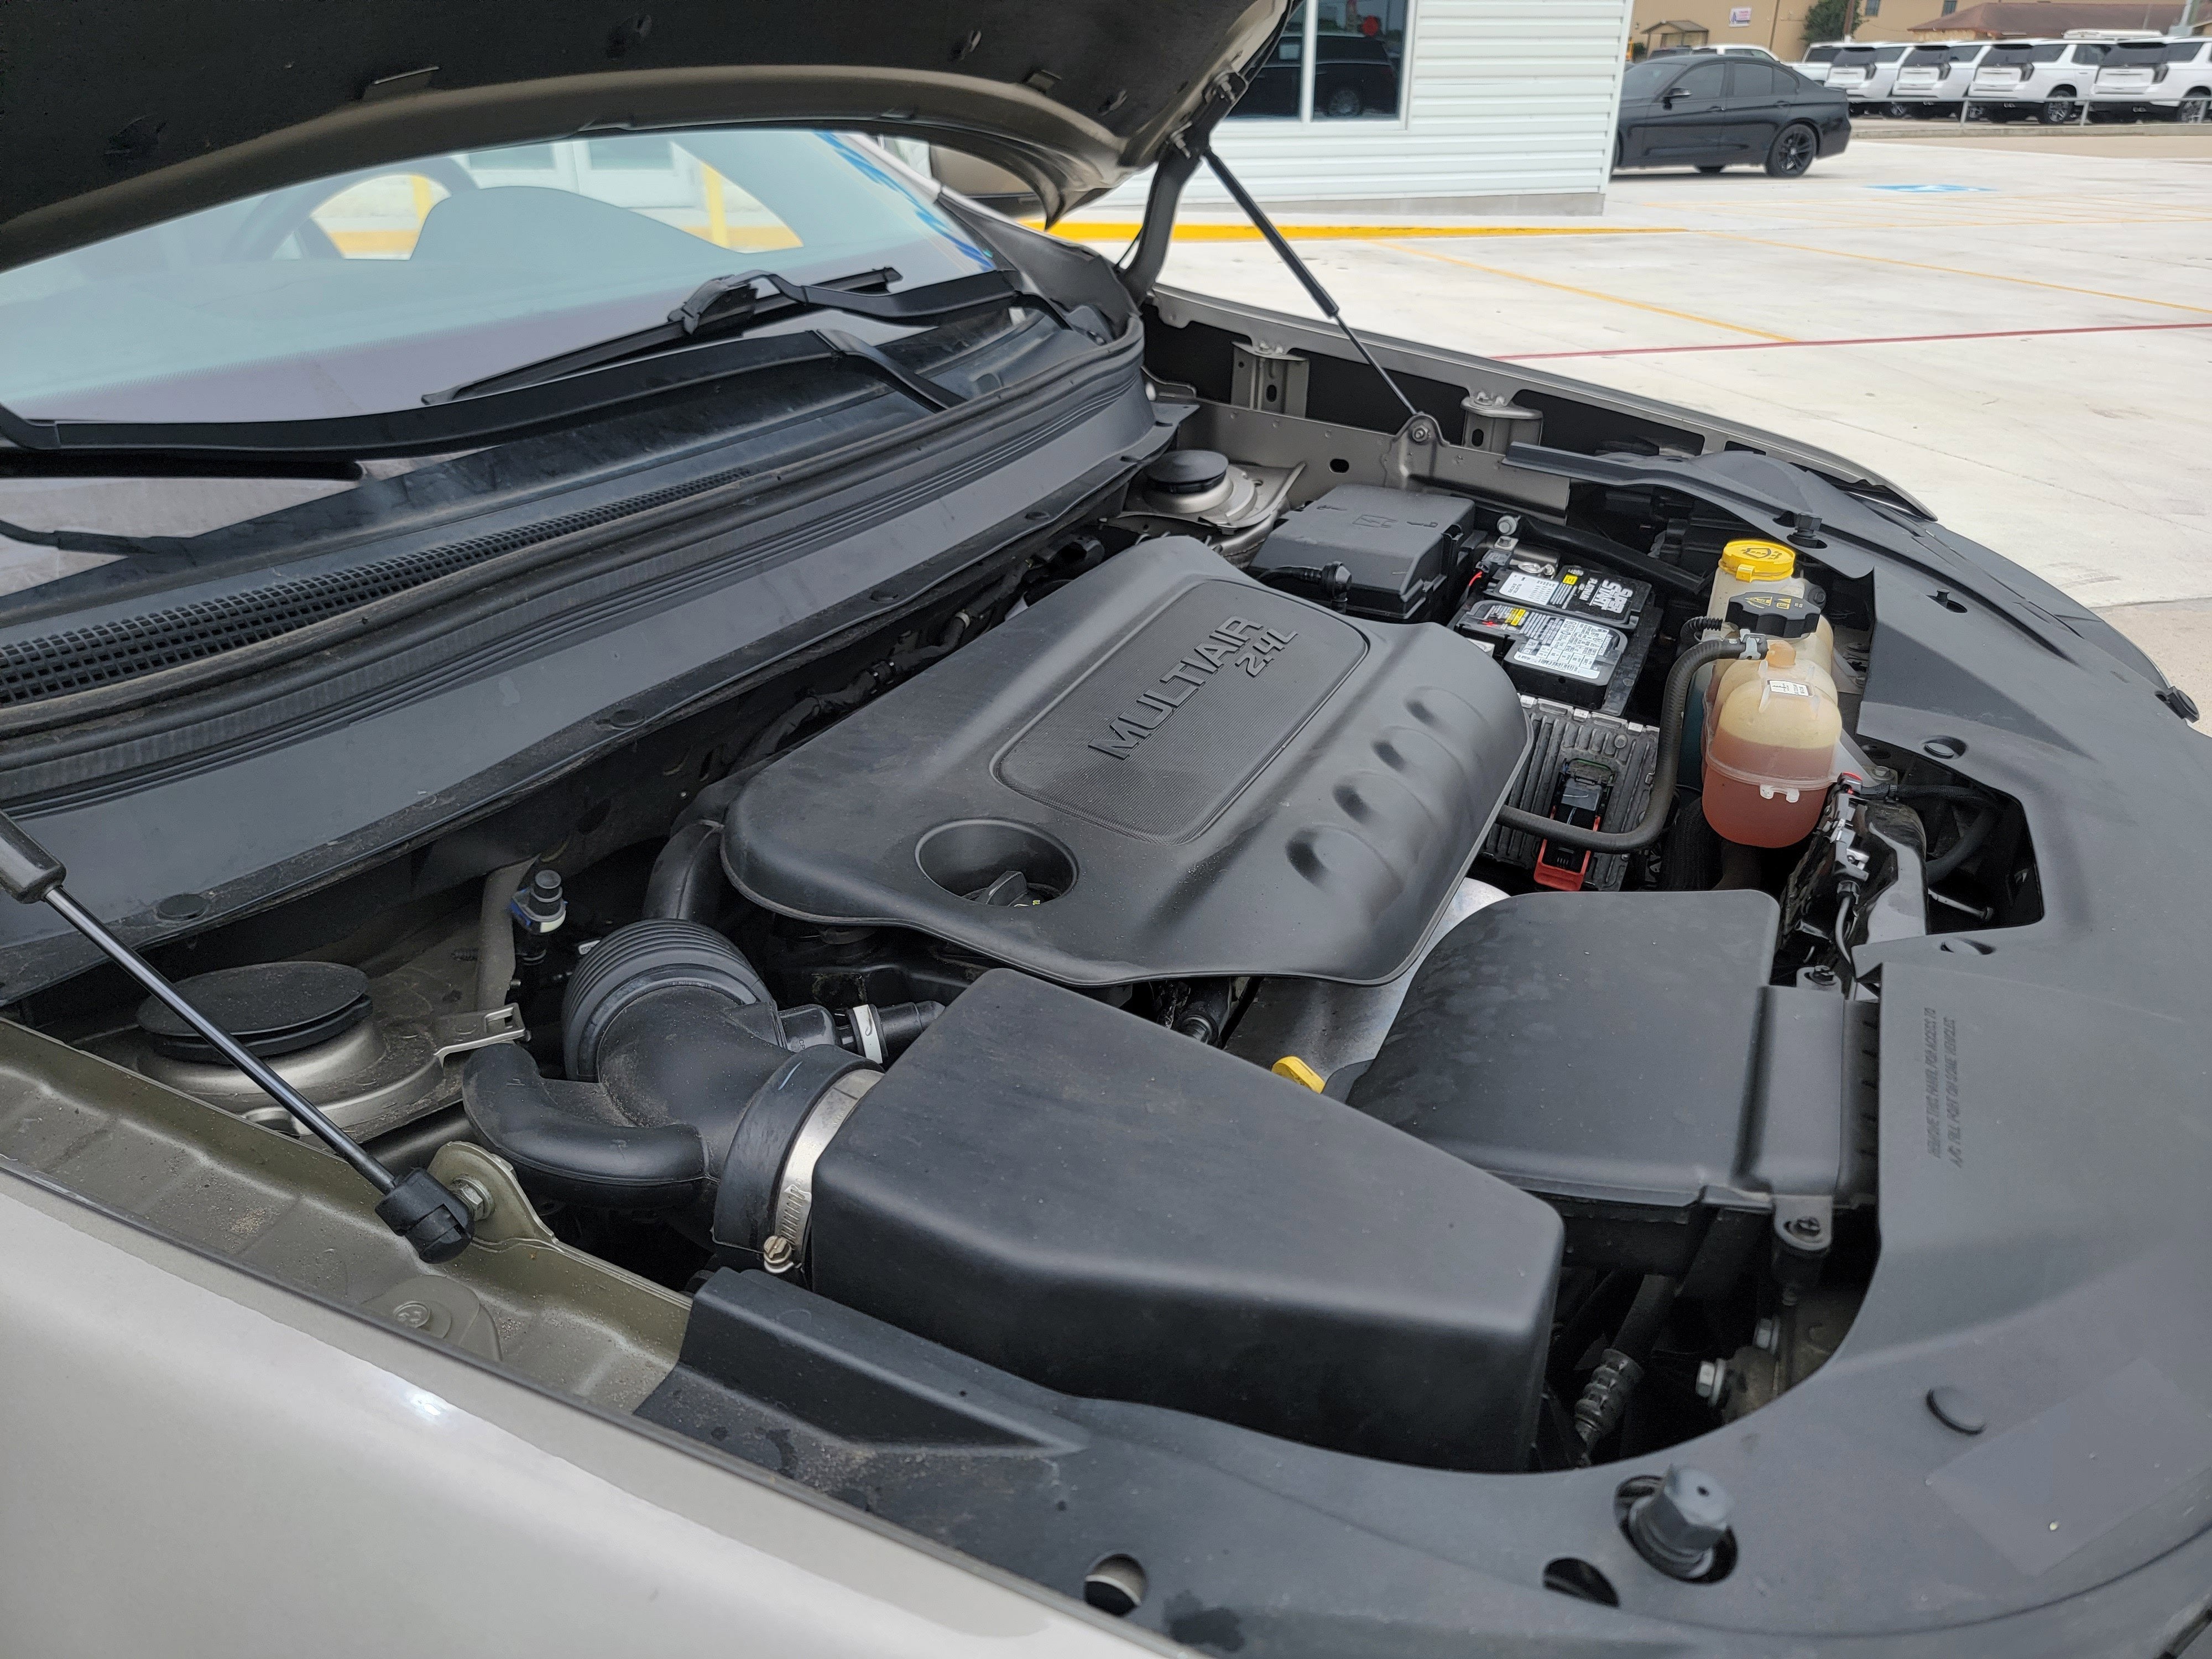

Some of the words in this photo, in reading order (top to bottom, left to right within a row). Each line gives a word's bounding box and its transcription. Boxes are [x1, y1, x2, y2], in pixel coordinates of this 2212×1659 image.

[1579, 577, 1598, 601] PLATINUM
[1593, 579, 1623, 611] START
[1235, 628, 1298, 677] 2.4L
[1087, 615, 1264, 760] MULTIAIR
[1924, 1018, 1937, 1051] ACCESS
